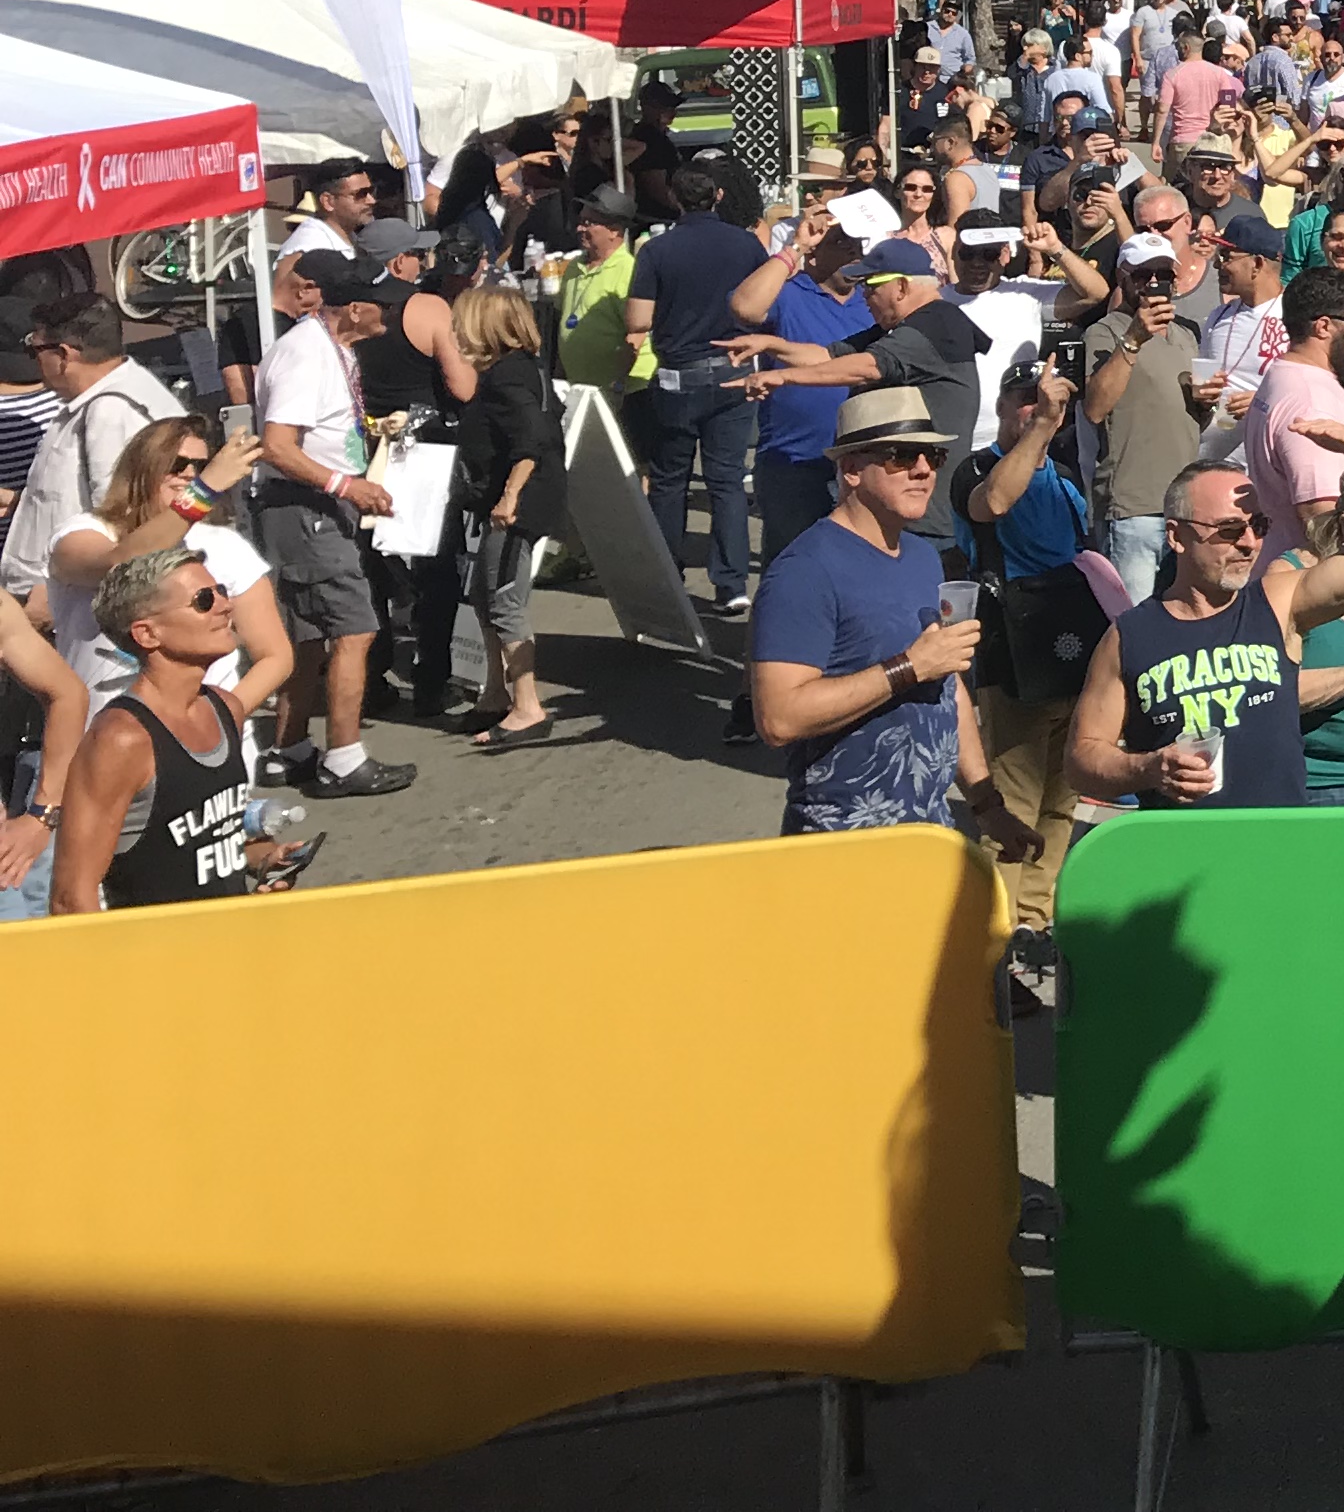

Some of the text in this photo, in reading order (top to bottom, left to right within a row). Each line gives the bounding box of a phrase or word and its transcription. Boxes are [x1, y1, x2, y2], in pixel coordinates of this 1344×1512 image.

[23, 162, 68, 204] HEALTH
[100, 141, 236, 191] CAN COMMUNITY HEALTH
[1136, 643, 1281, 714] SYRACUSE
[1152, 690, 1275, 726] EST 1847
[1179, 685, 1246, 735] NY
[196, 829, 248, 886] FUC
